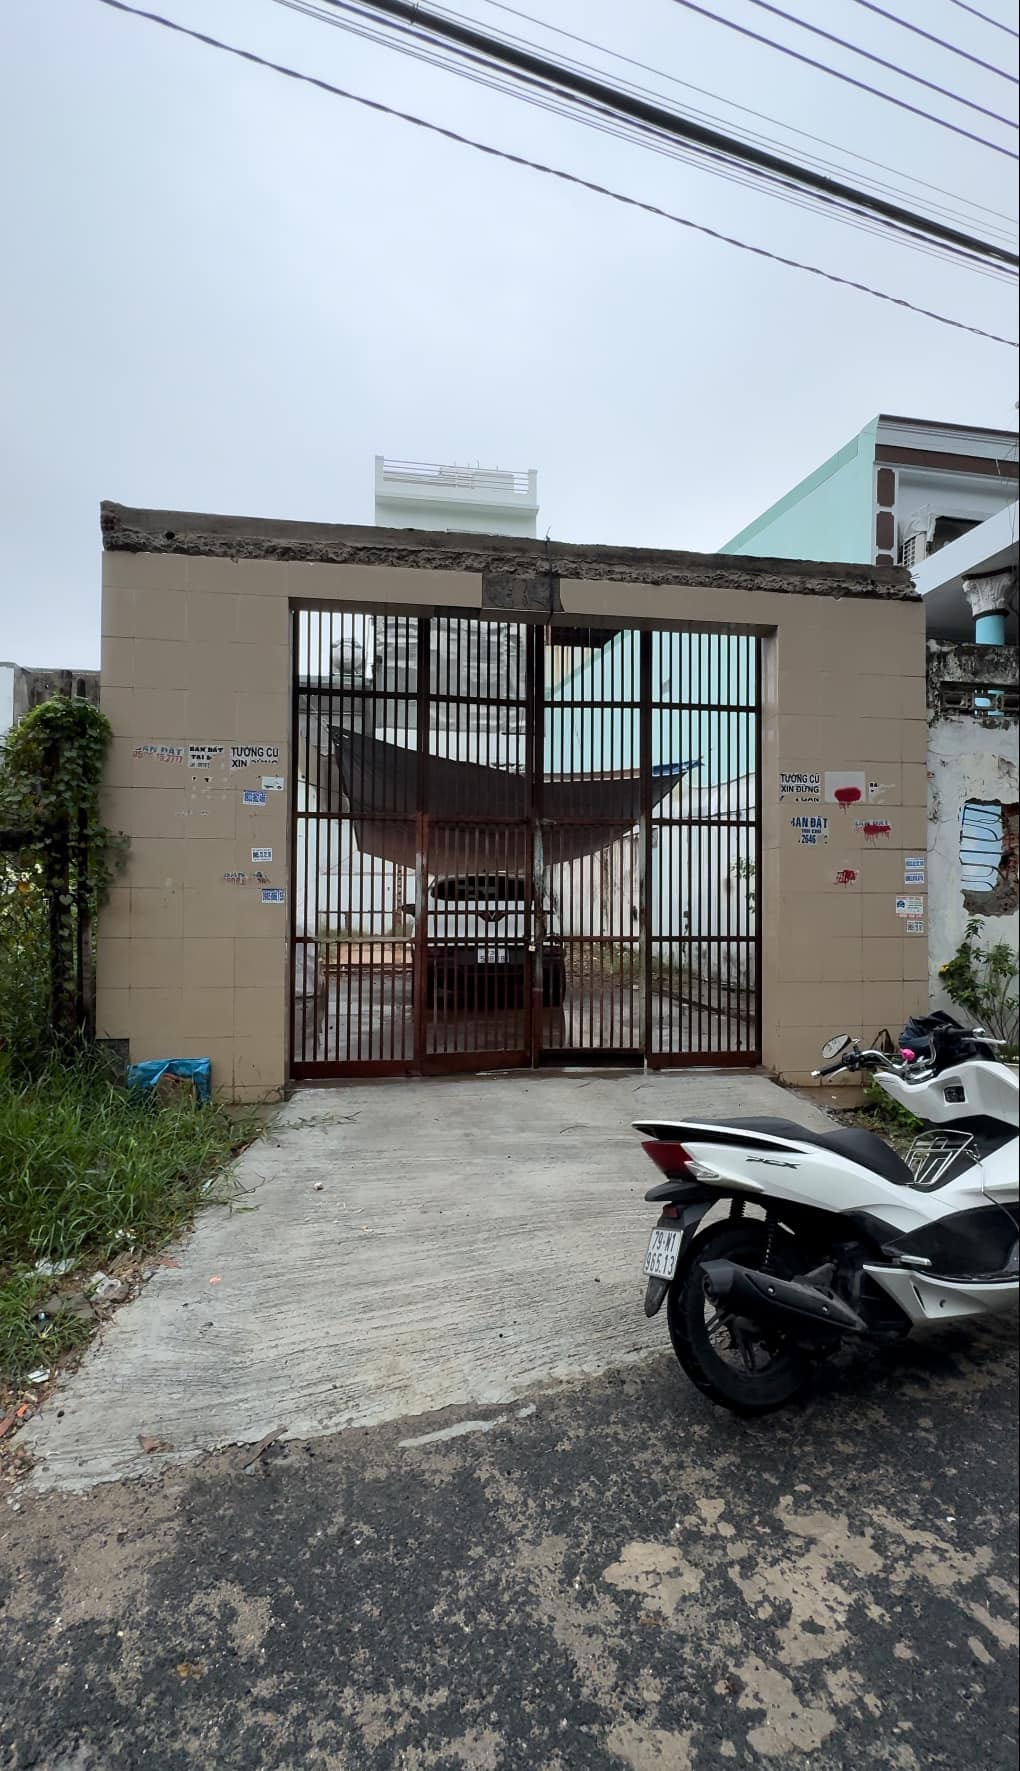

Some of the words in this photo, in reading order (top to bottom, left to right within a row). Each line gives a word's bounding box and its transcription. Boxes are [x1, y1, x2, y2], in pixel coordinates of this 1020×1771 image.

[231, 759, 248, 768] XIN
[780, 785, 794, 793] XIN
[745, 1155, 801, 1170] PCX
[651, 1230, 678, 1253] 79-N1
